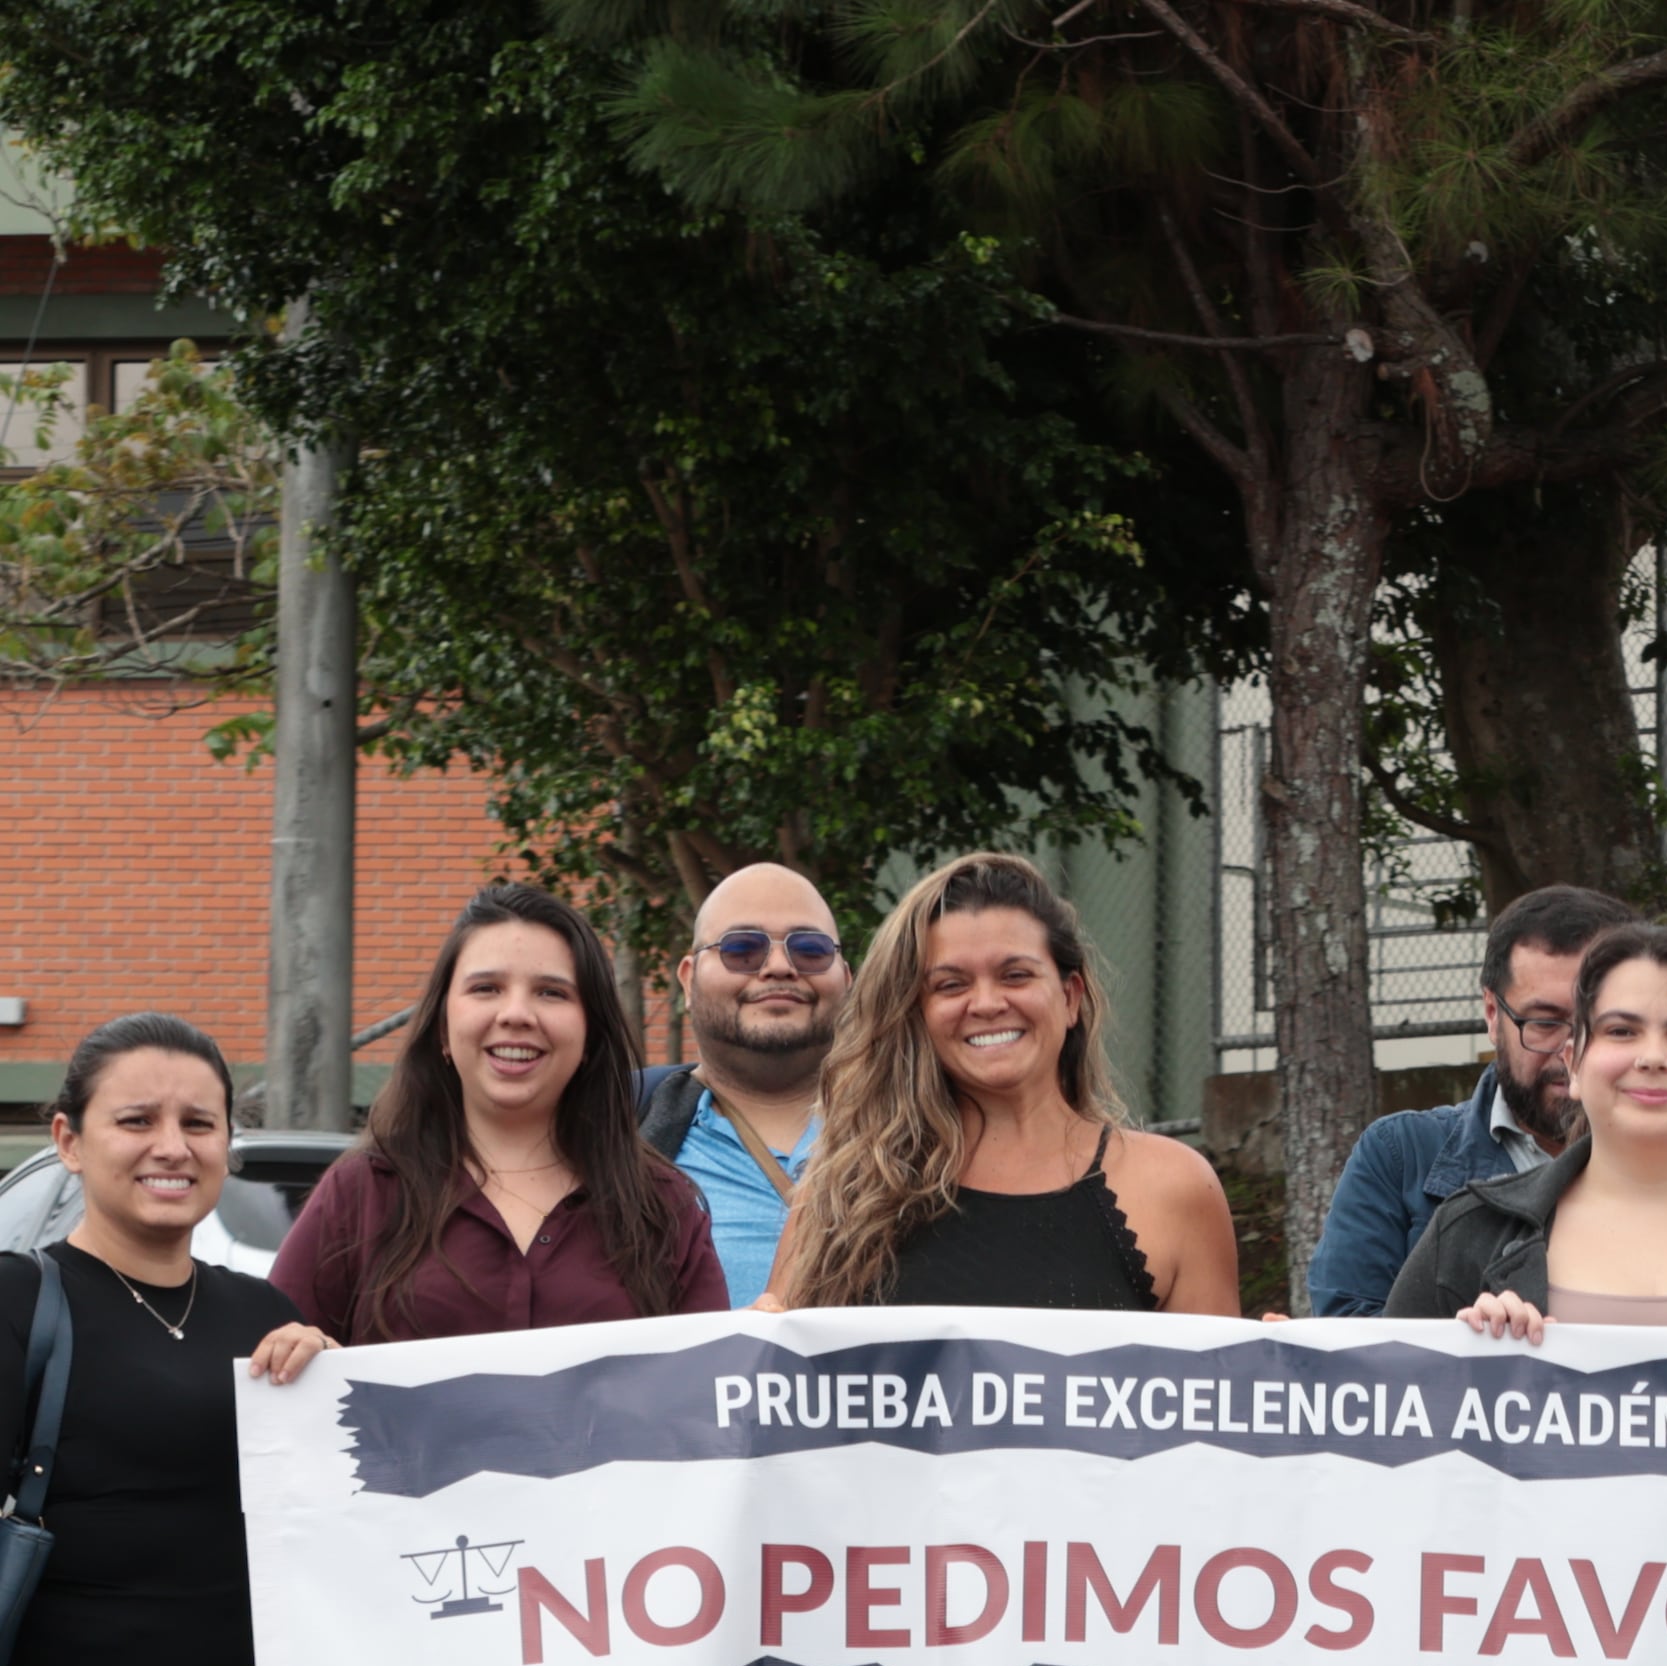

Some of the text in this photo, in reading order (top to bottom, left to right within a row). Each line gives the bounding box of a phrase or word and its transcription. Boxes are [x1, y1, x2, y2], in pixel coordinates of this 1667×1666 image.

[715, 1373, 953, 1429] PRUEBA
[972, 1372, 1045, 1425] DE
[1065, 1375, 1433, 1437] EXCELENCIA
[518, 1546, 725, 1664] NO
[760, 1541, 1374, 1650] PEDIMOS
